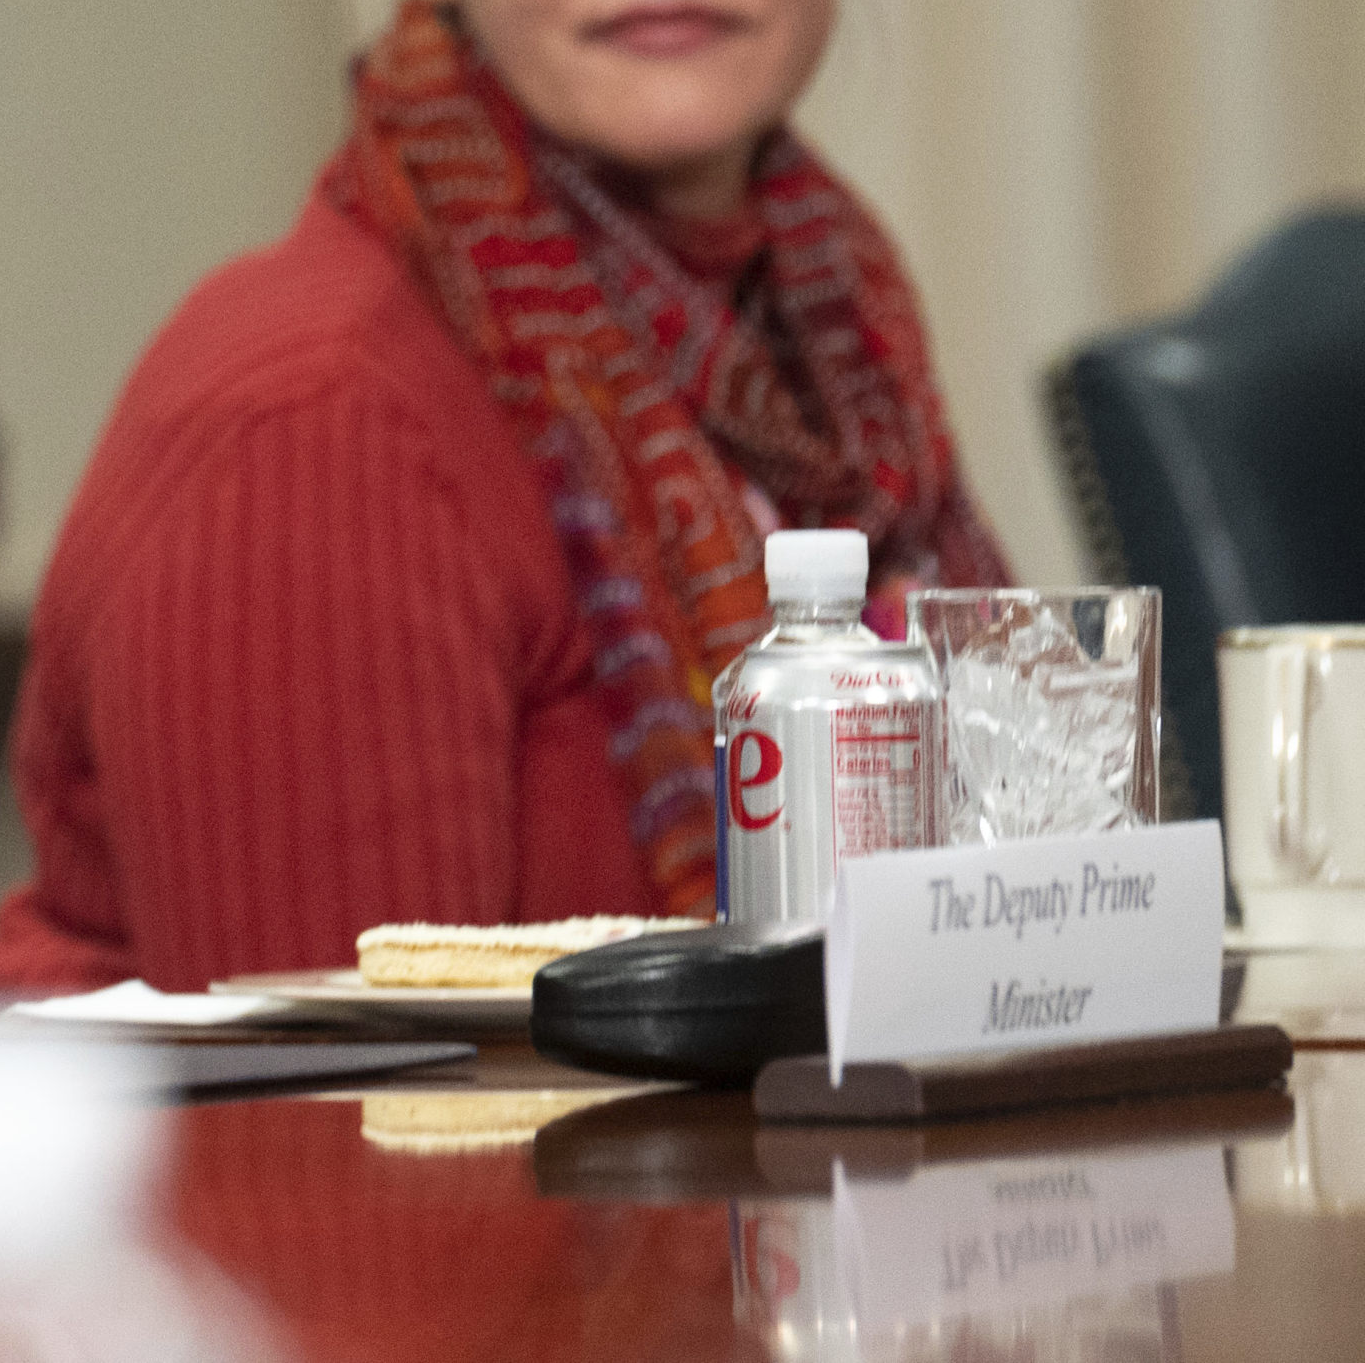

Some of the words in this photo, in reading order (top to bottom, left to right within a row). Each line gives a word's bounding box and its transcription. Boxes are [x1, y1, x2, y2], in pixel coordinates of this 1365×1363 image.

[726, 681, 761, 722] iet
[929, 877, 975, 933] The
[984, 872, 1071, 938] Deputy
[1080, 861, 1156, 917] Prime
[982, 979, 1093, 1034] Minister
